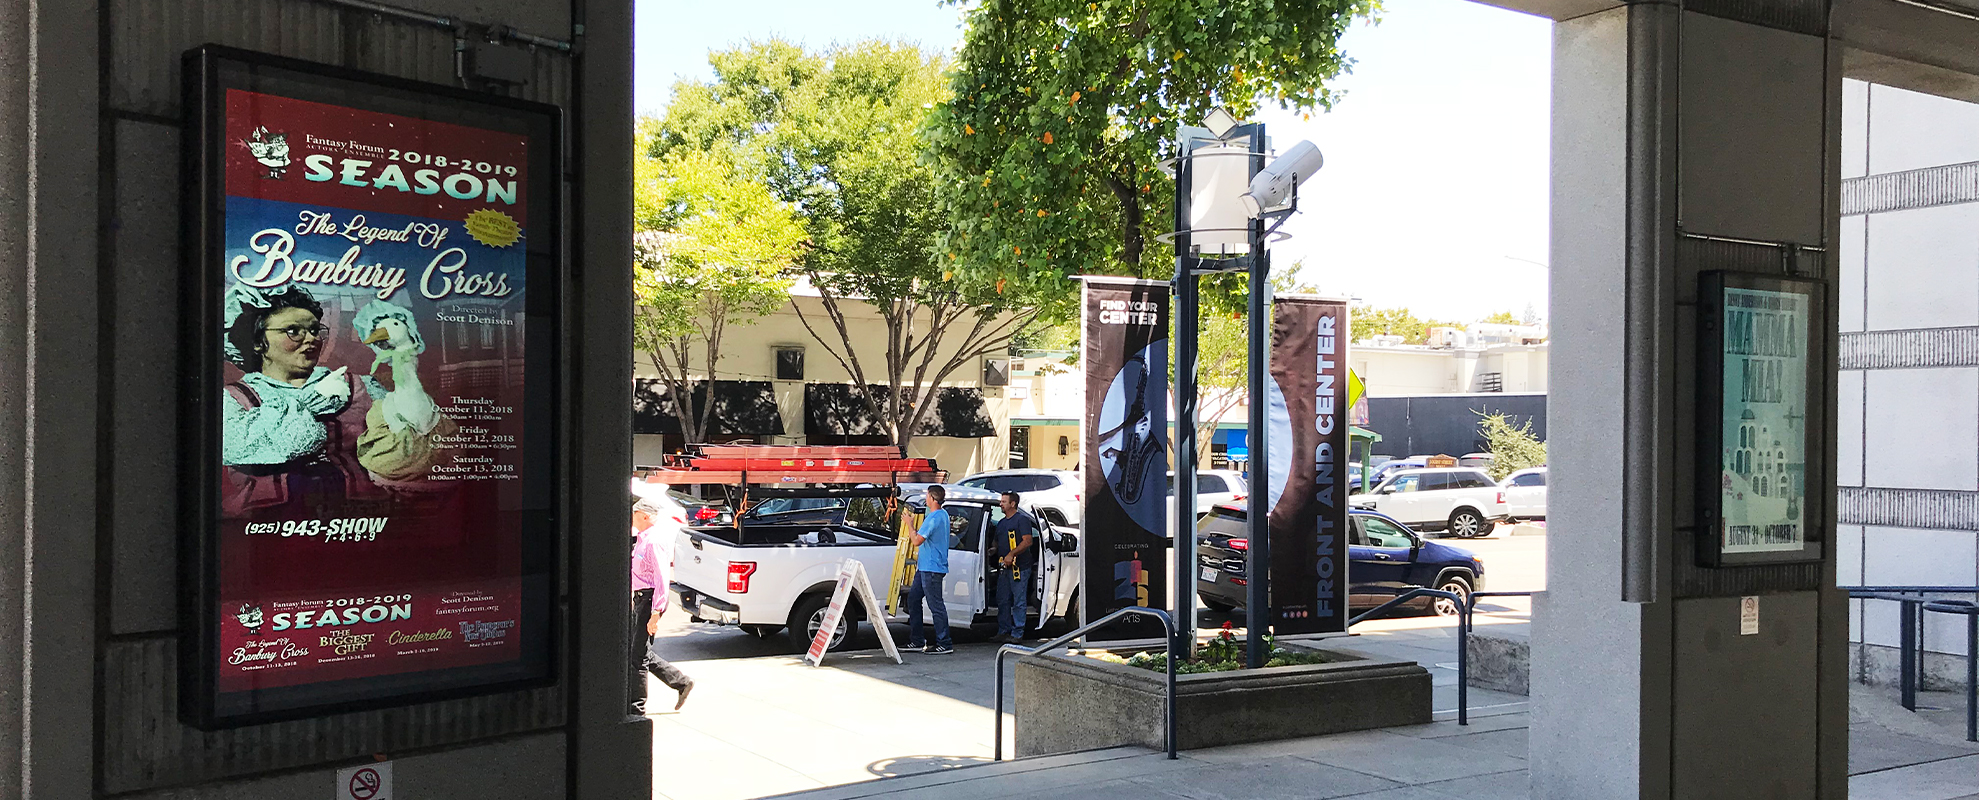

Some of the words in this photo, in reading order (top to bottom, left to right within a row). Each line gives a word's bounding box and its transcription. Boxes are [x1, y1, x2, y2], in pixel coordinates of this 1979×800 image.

[306, 134, 347, 150] Fantasy
[349, 140, 384, 153] Forum
[388, 148, 517, 177] 2018-2019
[304, 153, 517, 205] SEASON
[296, 210, 337, 236] The
[337, 213, 414, 245] Legend
[414, 222, 449, 249] Of
[231, 228, 406, 299] Banbury
[420, 246, 512, 299] Cross
[452, 304, 488, 315] Directed
[1099, 299, 1127, 311] FIND
[1128, 300, 1158, 312] YOUR
[436, 311, 465, 322] Scott
[468, 314, 514, 326] Denison
[1098, 310, 1158, 326] CENTER
[1726, 310, 1798, 358] MAMMA
[1316, 315, 1336, 435] CENTER
[1741, 358, 1784, 404] MIA!
[432, 404, 470, 413] October
[473, 406, 488, 414] 11,
[490, 406, 513, 414] 2018
[451, 396, 495, 407] Thursday
[459, 426, 490, 436] Friday
[432, 434, 472, 443] October
[475, 434, 489, 444] 12,
[491, 434, 515, 443] 2018
[453, 455, 494, 465] Saturday
[431, 464, 472, 473] October
[474, 465, 489, 473] 13,
[491, 464, 514, 473] 2018
[1316, 443, 1334, 509] AND
[463, 474, 488, 482] 1:00pm
[245, 521, 280, 536] (925)
[281, 517, 389, 537] 943-SHOW
[1728, 524, 1751, 546] AUGUST
[1751, 524, 1759, 545] 31
[1764, 523, 1791, 544] OCTOBER
[1791, 524, 1797, 543] 7
[1114, 543, 1149, 551] CELEBRATING
[1316, 515, 1334, 618] FRONT
[273, 601, 300, 609] Fantasy
[301, 599, 324, 607] Forum
[326, 593, 412, 608] 2018-2019
[441, 597, 461, 605] Scott
[463, 595, 495, 604] Denison
[272, 603, 412, 631] SEASON
[435, 605, 500, 616] fantasyforum.org
[1122, 613, 1142, 623] Arts
[318, 633, 375, 648] BIGGEST
[329, 629, 350, 638] THE
[388, 627, 453, 646] Cinderella
[228, 647, 278, 665] Banbury
[280, 642, 310, 660] Cross
[334, 643, 368, 656] GIFT
[317, 656, 346, 664] December
